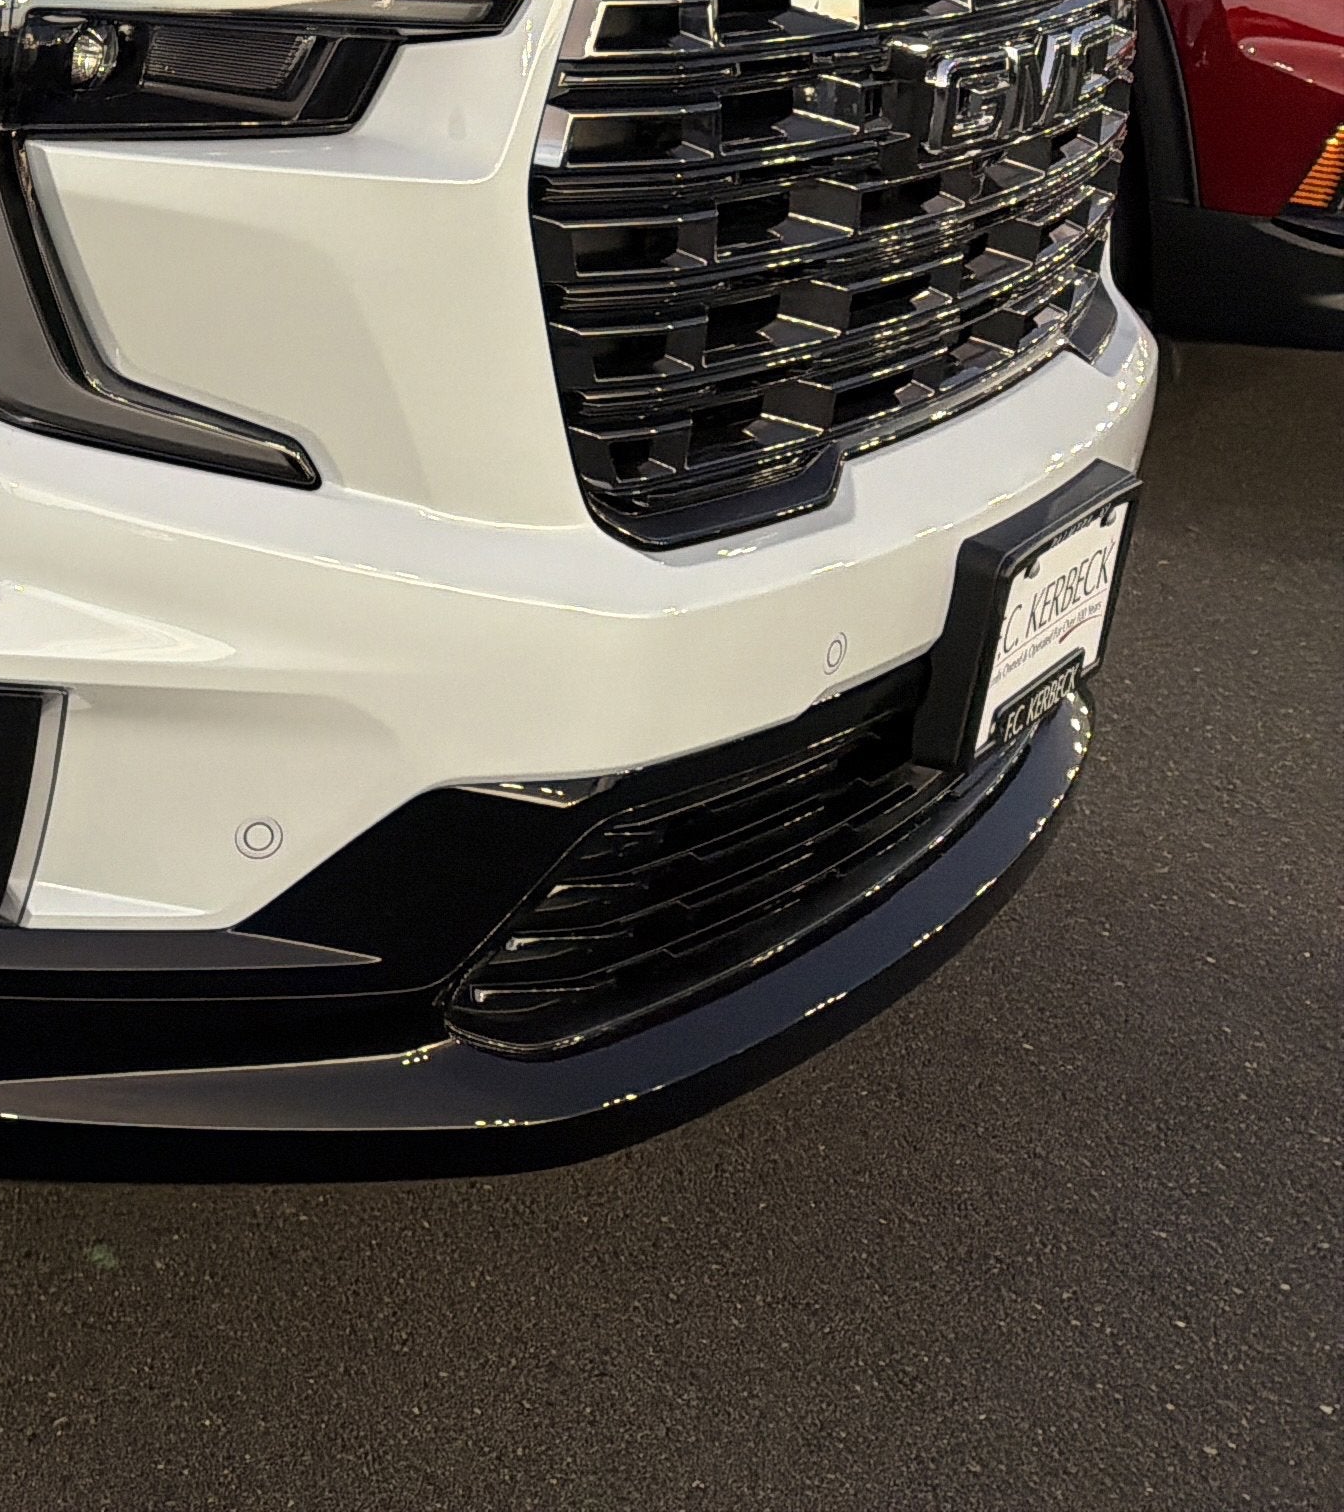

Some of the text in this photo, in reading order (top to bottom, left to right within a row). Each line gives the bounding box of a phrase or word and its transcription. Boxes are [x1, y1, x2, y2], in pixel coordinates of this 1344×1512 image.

[924, 15, 1114, 155] GMC
[1025, 541, 1116, 639] KERBECK
[1025, 662, 1081, 726] KERBECK
